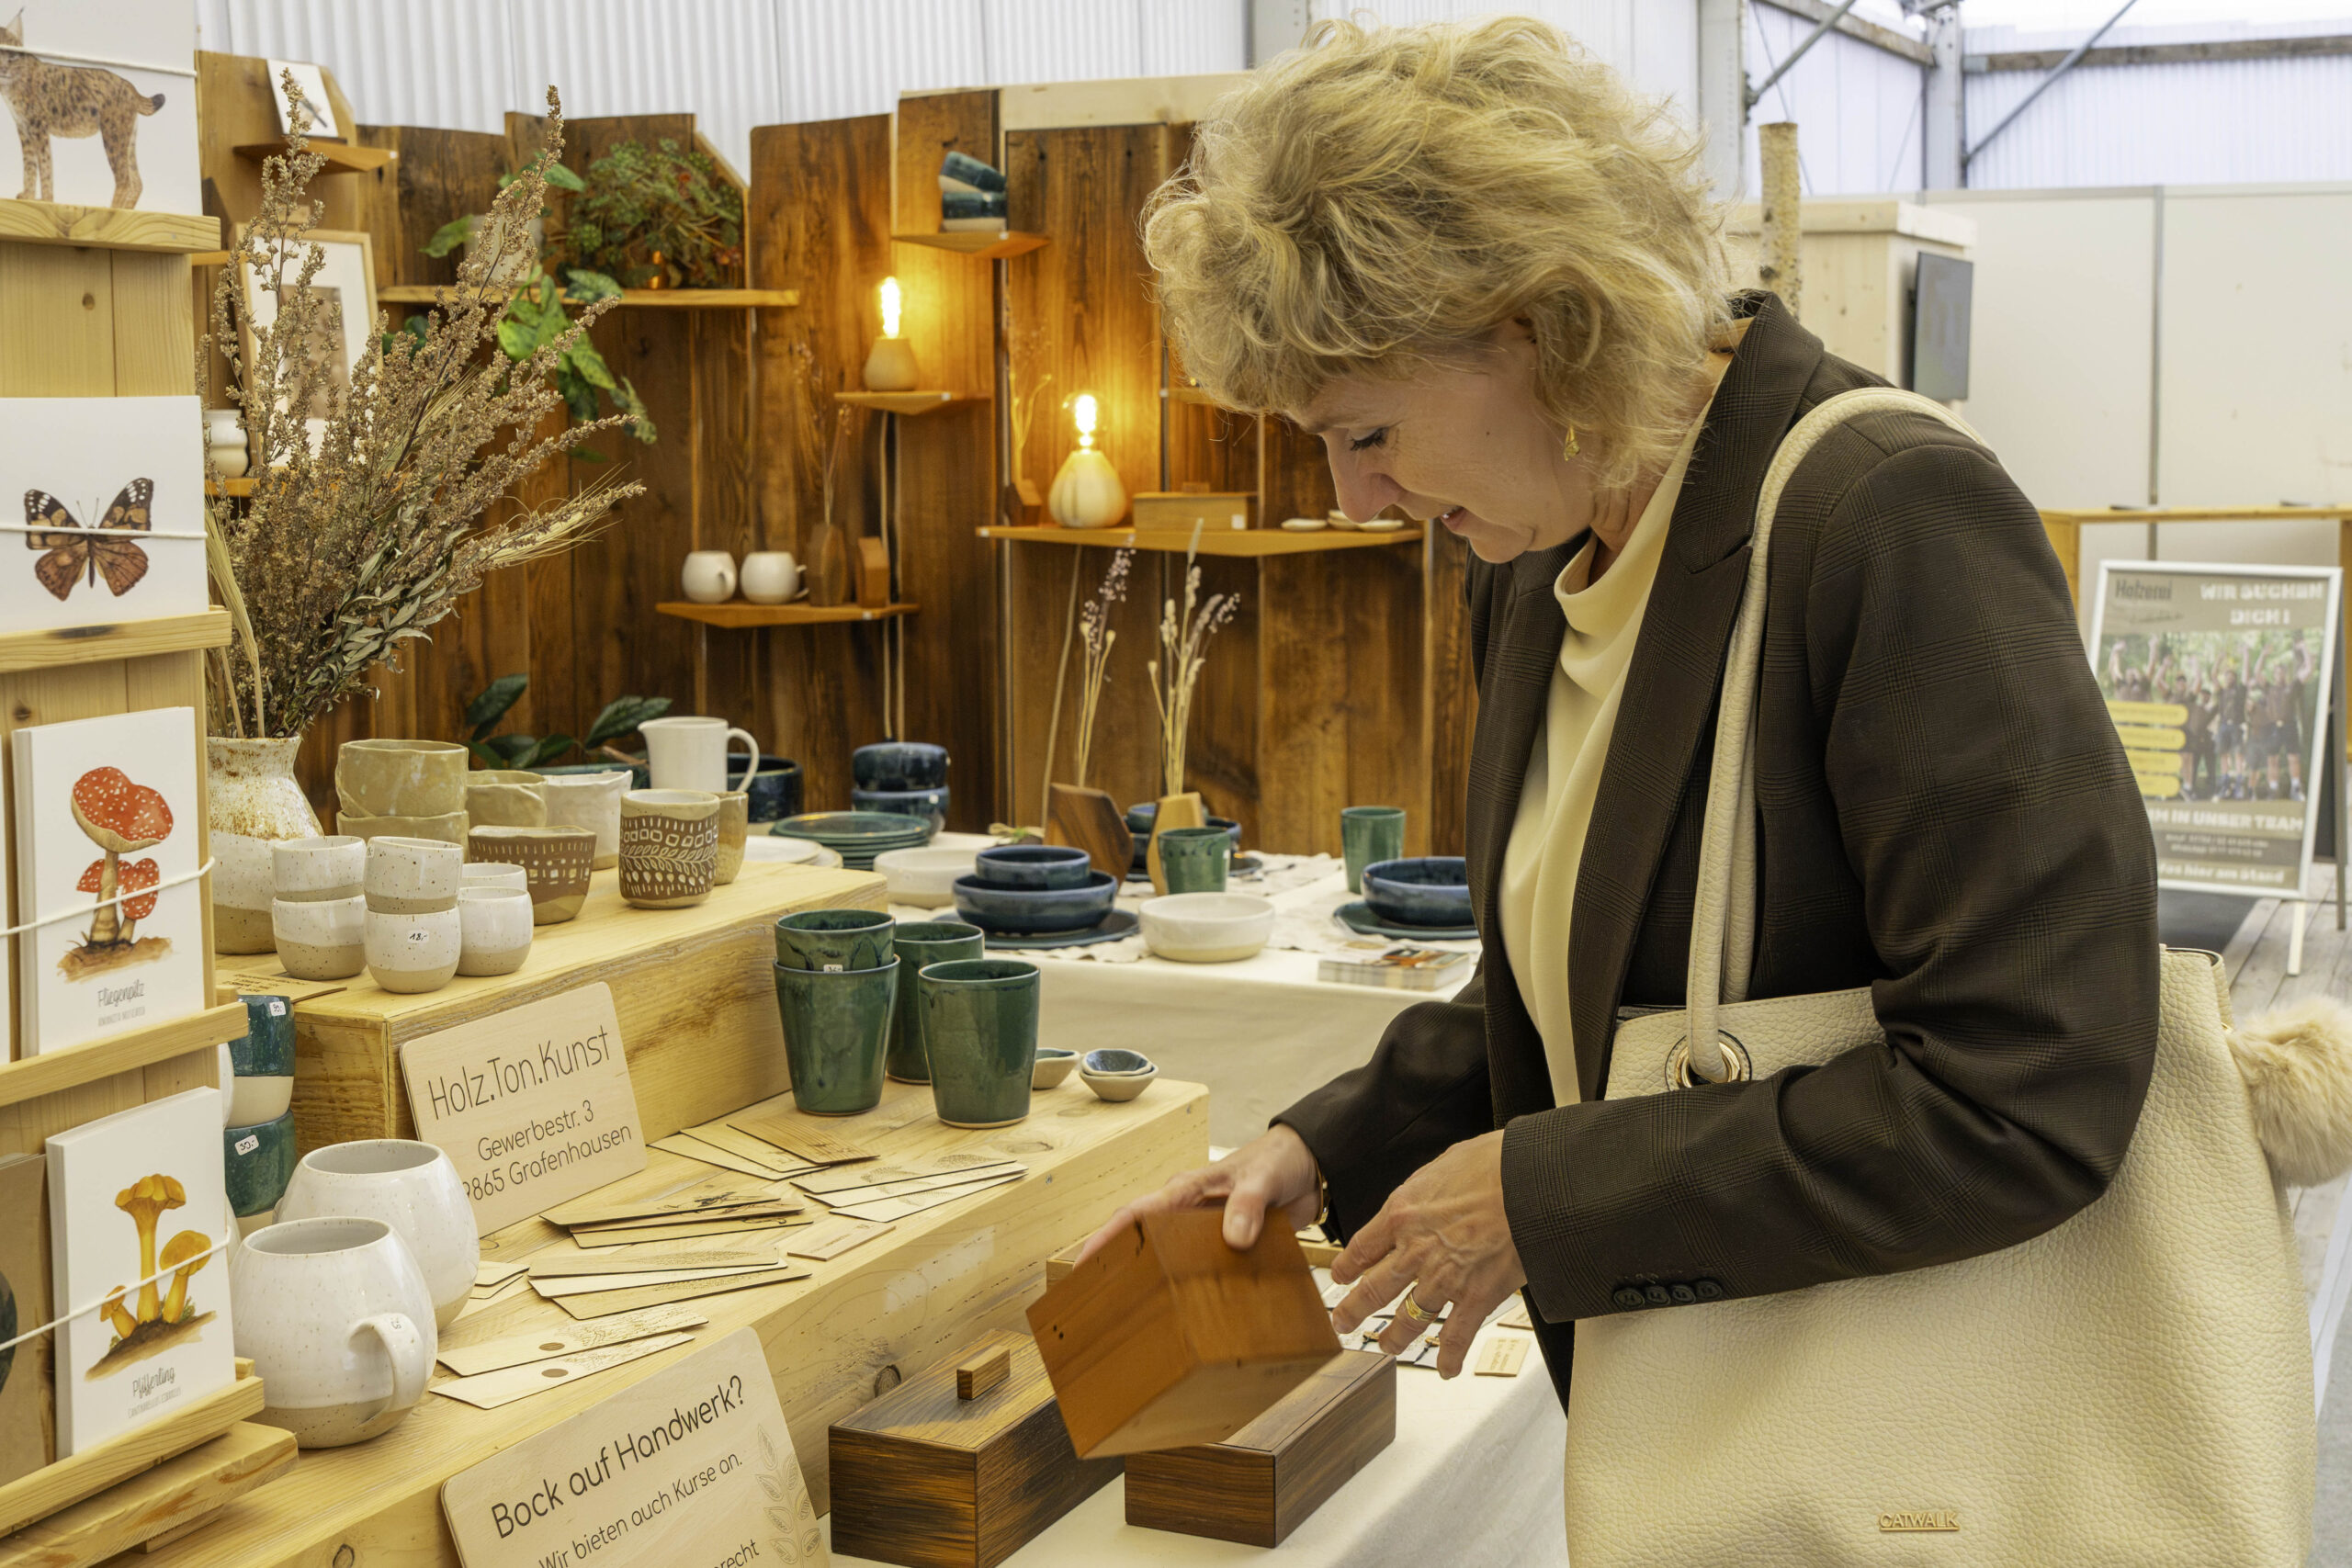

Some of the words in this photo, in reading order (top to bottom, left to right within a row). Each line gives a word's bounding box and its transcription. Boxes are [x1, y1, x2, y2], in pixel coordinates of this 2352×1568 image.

[2255, 814, 2304, 831] TEAM
[427, 1024, 611, 1121] Holz.Ton.Kunst
[477, 1110, 581, 1161] Gewerbestr.
[582, 1099, 594, 1122] 3
[508, 1124, 632, 1186] Grafenhausen
[491, 1478, 564, 1539] Bock
[569, 1446, 611, 1496] auf
[614, 1374, 744, 1471] Handwerk?
[571, 1518, 629, 1560] bieten
[631, 1490, 673, 1527] auch
[672, 1466, 717, 1502] Kurse
[718, 1453, 743, 1474] an.
[1878, 1512, 1960, 1529] CATWALK
[713, 1539, 760, 1568] recht
